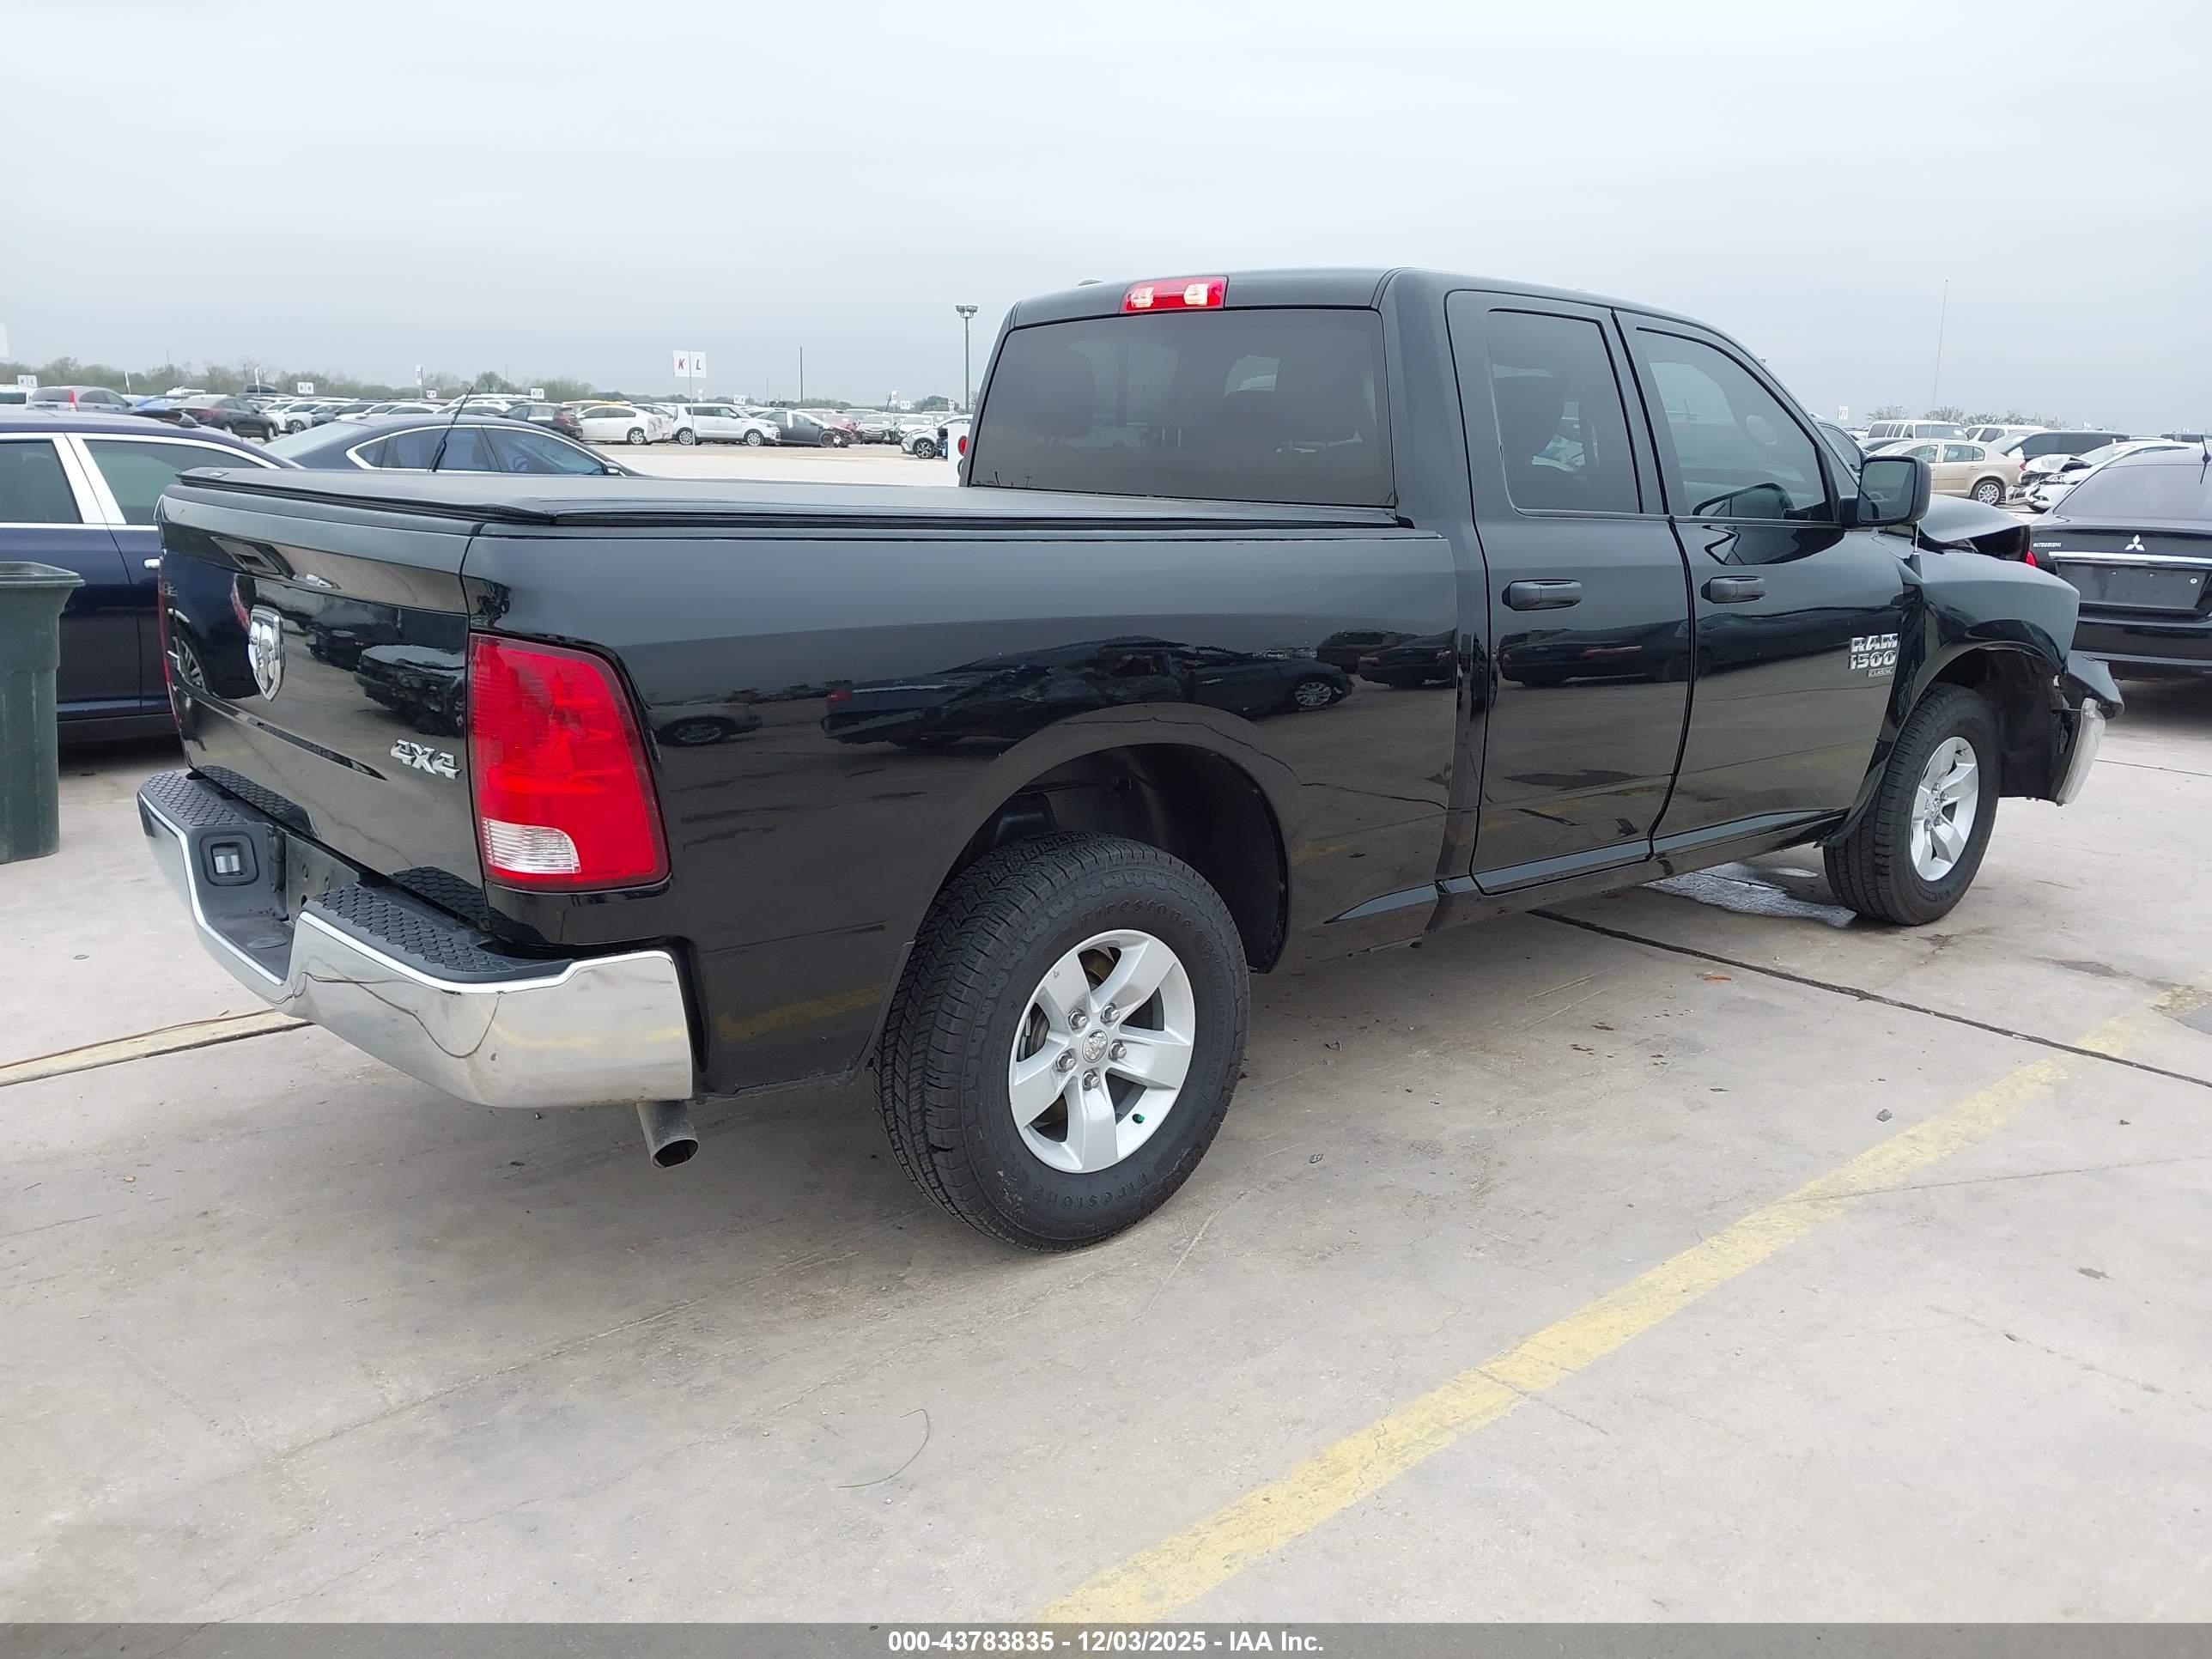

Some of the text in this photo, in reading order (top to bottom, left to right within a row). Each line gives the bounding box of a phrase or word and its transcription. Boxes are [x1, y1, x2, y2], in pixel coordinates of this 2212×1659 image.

[678, 357, 702, 370] K L
[1850, 633, 1899, 653] RAM
[1850, 650, 1896, 670] 1500
[1079, 898, 1194, 930] Firestone
